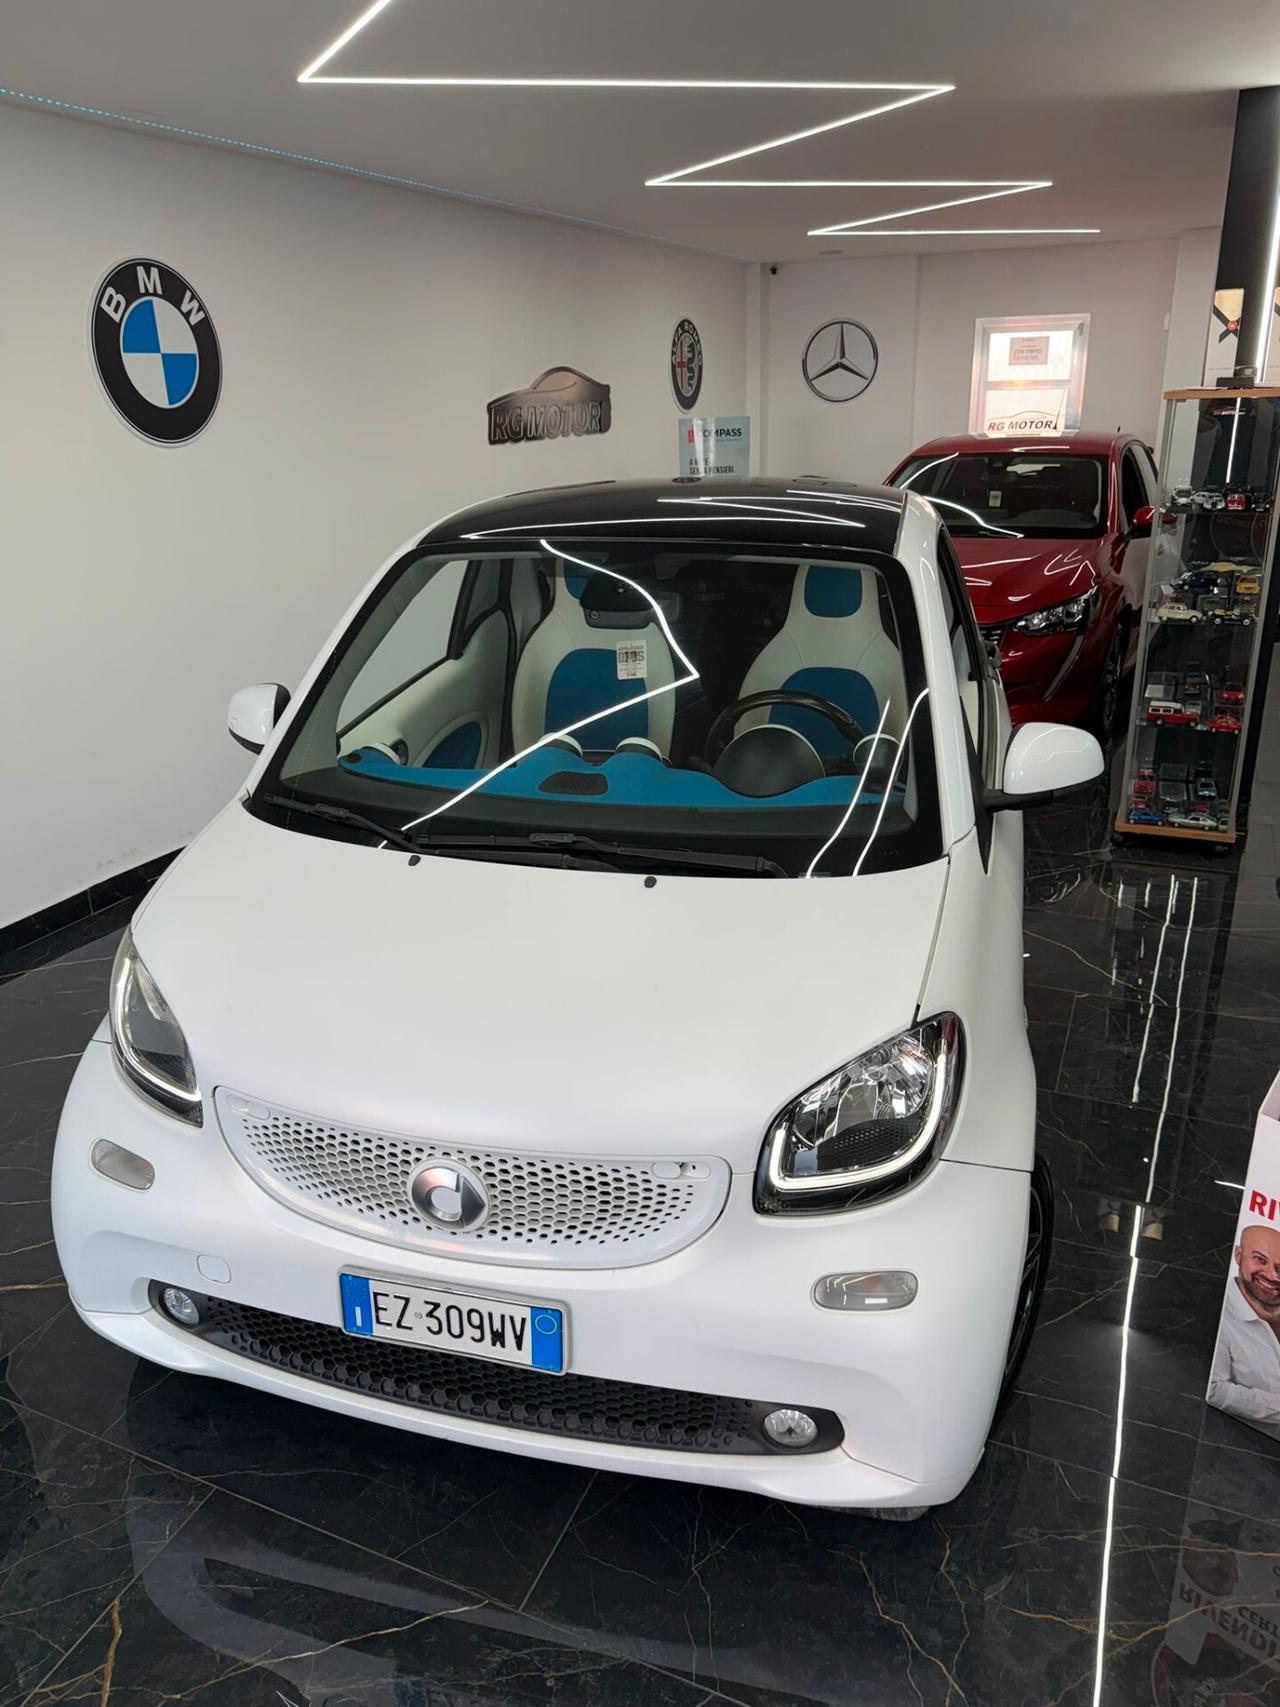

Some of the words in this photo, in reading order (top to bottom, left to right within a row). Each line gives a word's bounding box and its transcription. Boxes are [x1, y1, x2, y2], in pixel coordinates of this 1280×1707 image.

[100, 265, 206, 326] BMW
[491, 406, 524, 441] RG
[527, 402, 601, 438] MOTOR
[987, 422, 1005, 431] RG
[1008, 420, 1052, 430] MOTOR
[1248, 1189, 1280, 1221] RI
[372, 1291, 413, 1331] EZ
[423, 1299, 527, 1352] 309WV
